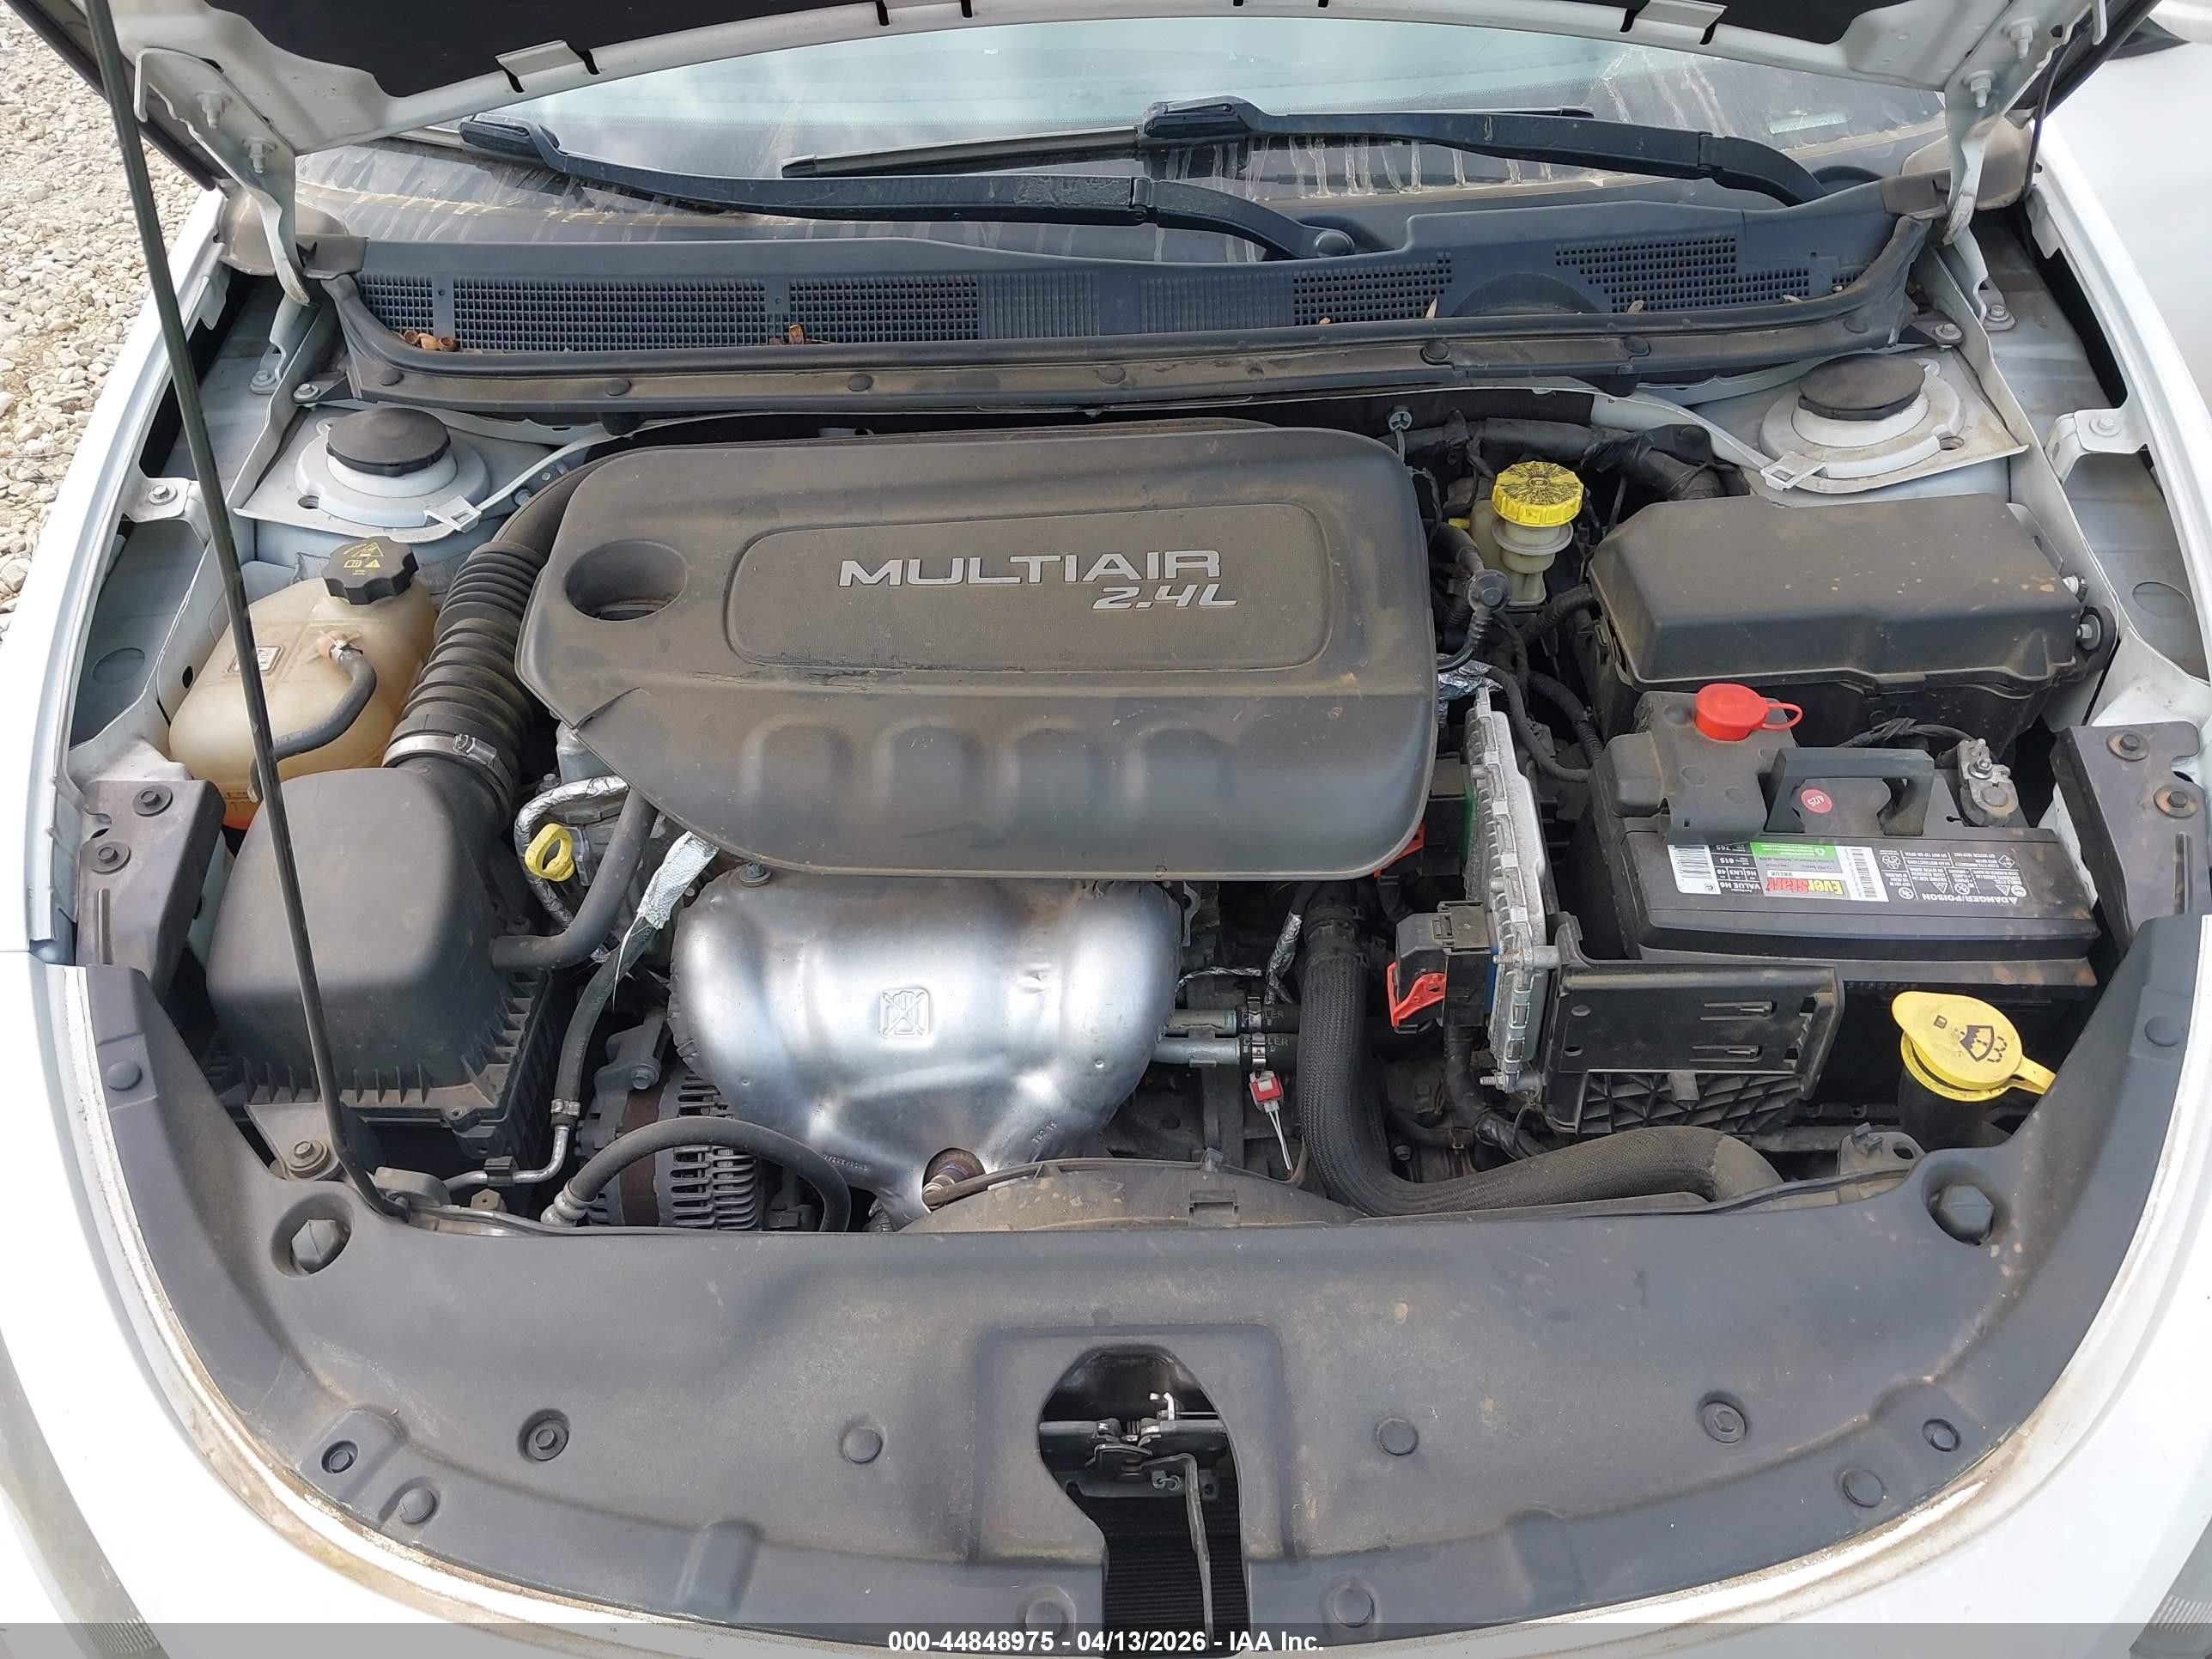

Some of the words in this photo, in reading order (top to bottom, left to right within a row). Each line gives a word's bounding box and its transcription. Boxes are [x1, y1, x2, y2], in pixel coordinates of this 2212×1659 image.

[838, 550, 1221, 587] MULTIAIR
[1092, 584, 1238, 611] 2.4L
[1807, 795, 1825, 807] 4/25
[1767, 878, 1844, 896] EverStart
[1921, 893, 2009, 903] DANGER/POISON
